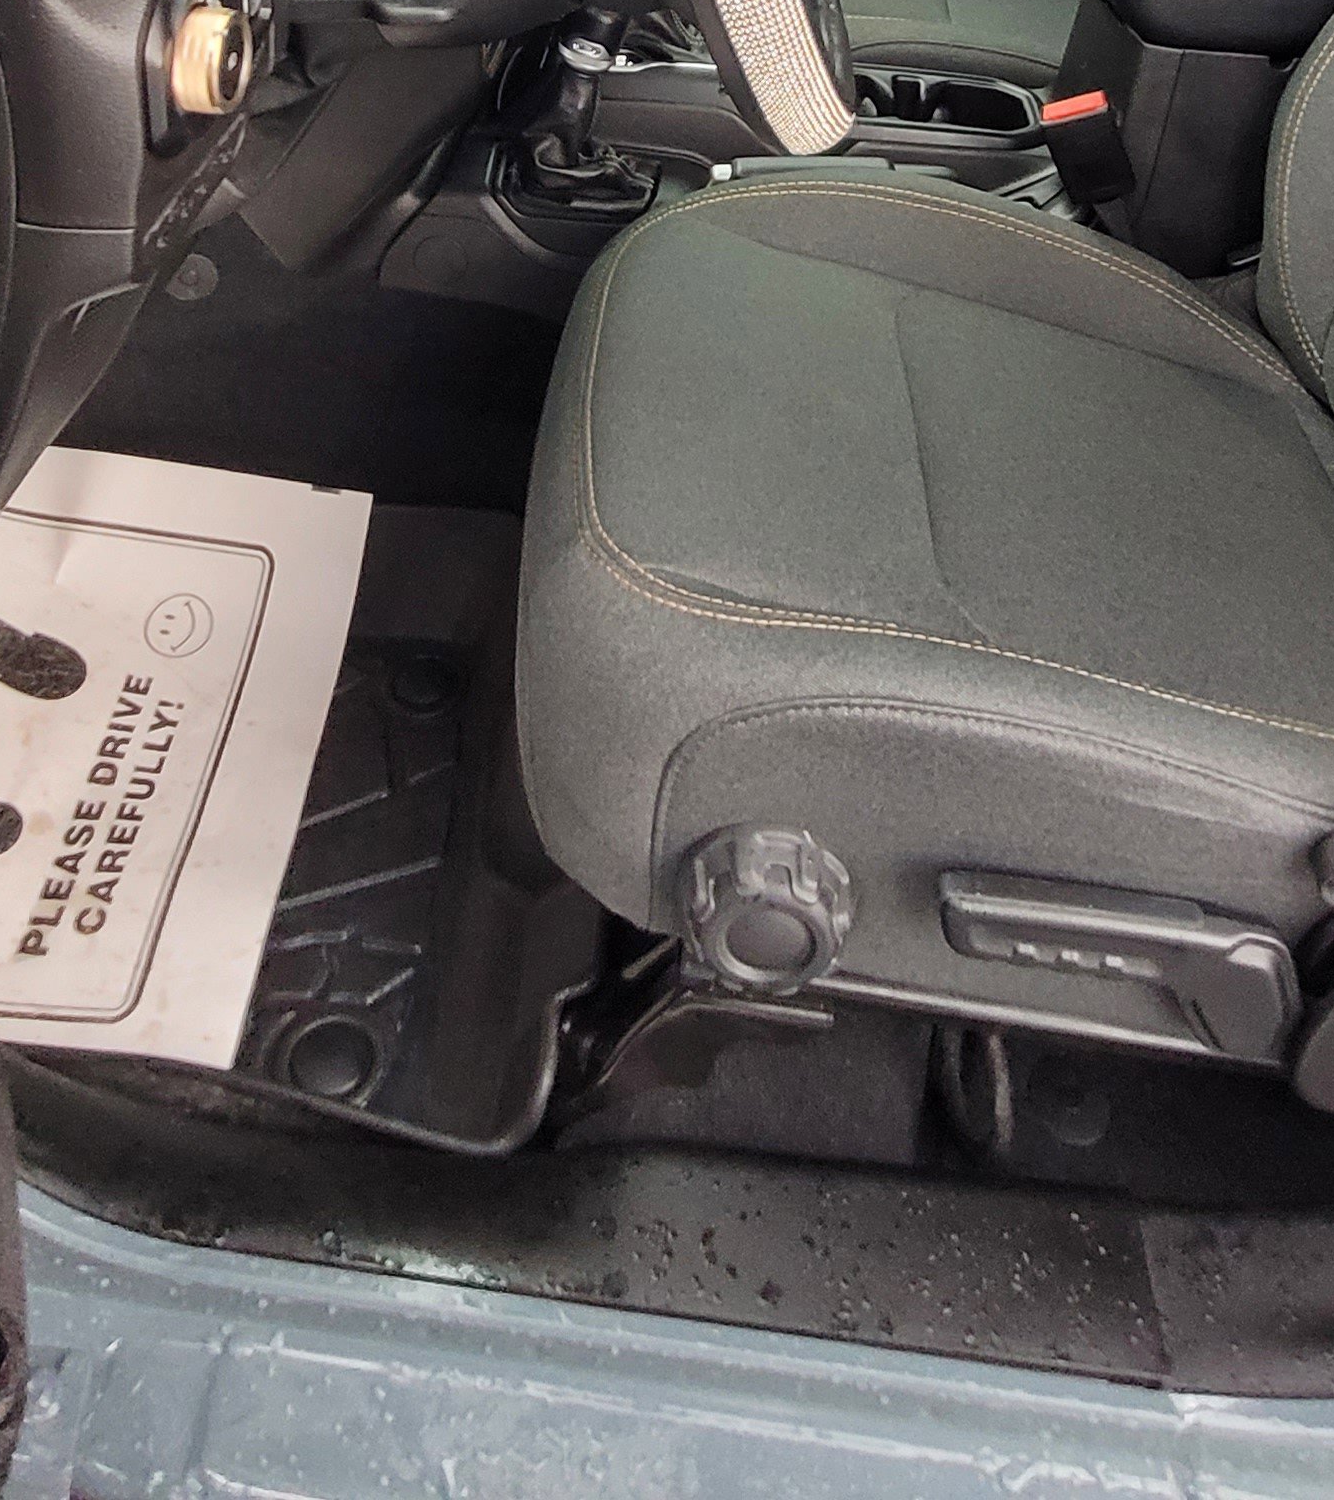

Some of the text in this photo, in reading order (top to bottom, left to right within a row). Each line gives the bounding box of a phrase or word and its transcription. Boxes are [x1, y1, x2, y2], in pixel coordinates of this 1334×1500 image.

[18, 673, 154, 957] PLEASE DRIVE
[72, 699, 185, 936] CAREFULLY!
